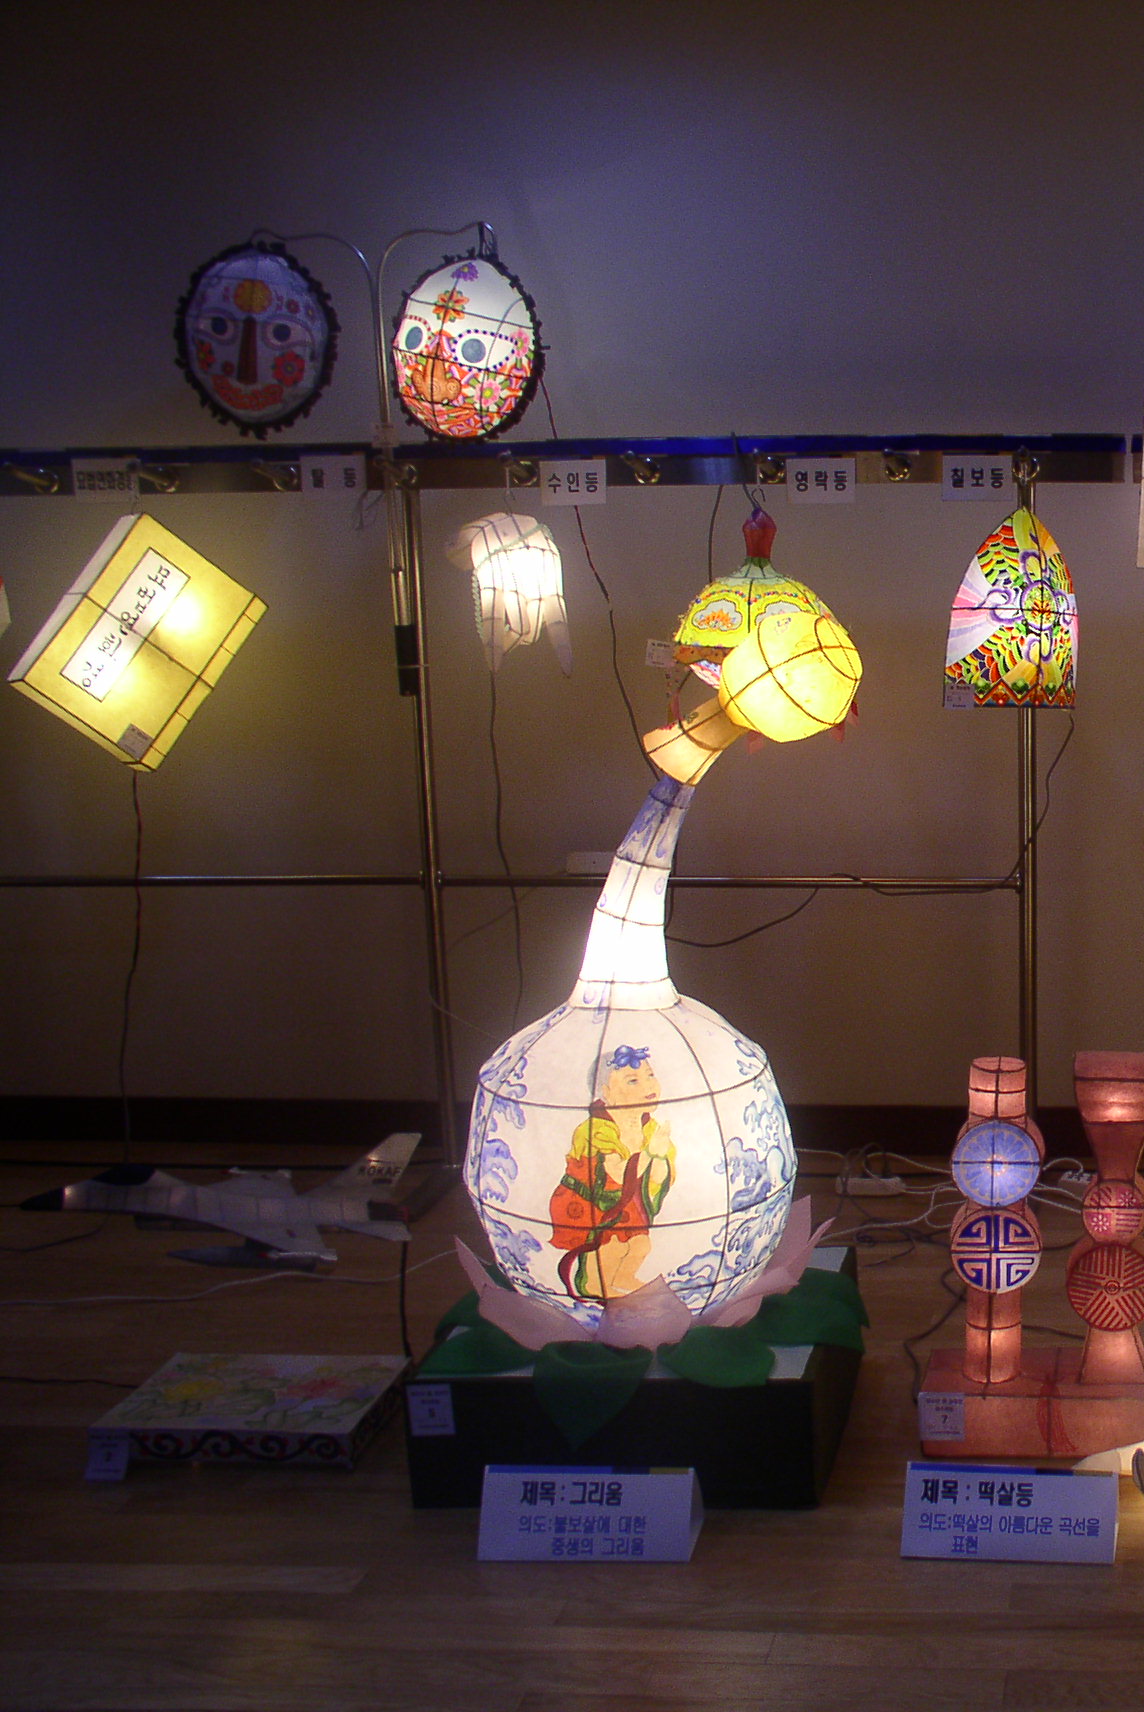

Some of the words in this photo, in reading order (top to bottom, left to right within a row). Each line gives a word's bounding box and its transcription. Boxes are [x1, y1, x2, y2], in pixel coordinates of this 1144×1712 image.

[548, 471, 599, 494] 수인등
[795, 470, 848, 492] 영락등
[951, 467, 1004, 489] 칠보등
[618, 1516, 647, 1535] 대한
[999, 1515, 1054, 1535] 아름다운
[1059, 1518, 1100, 1537] 곡선을
[551, 1537, 594, 1556] 중생의
[603, 1537, 645, 1556] 그리움
[951, 1536, 979, 1555] 표현
